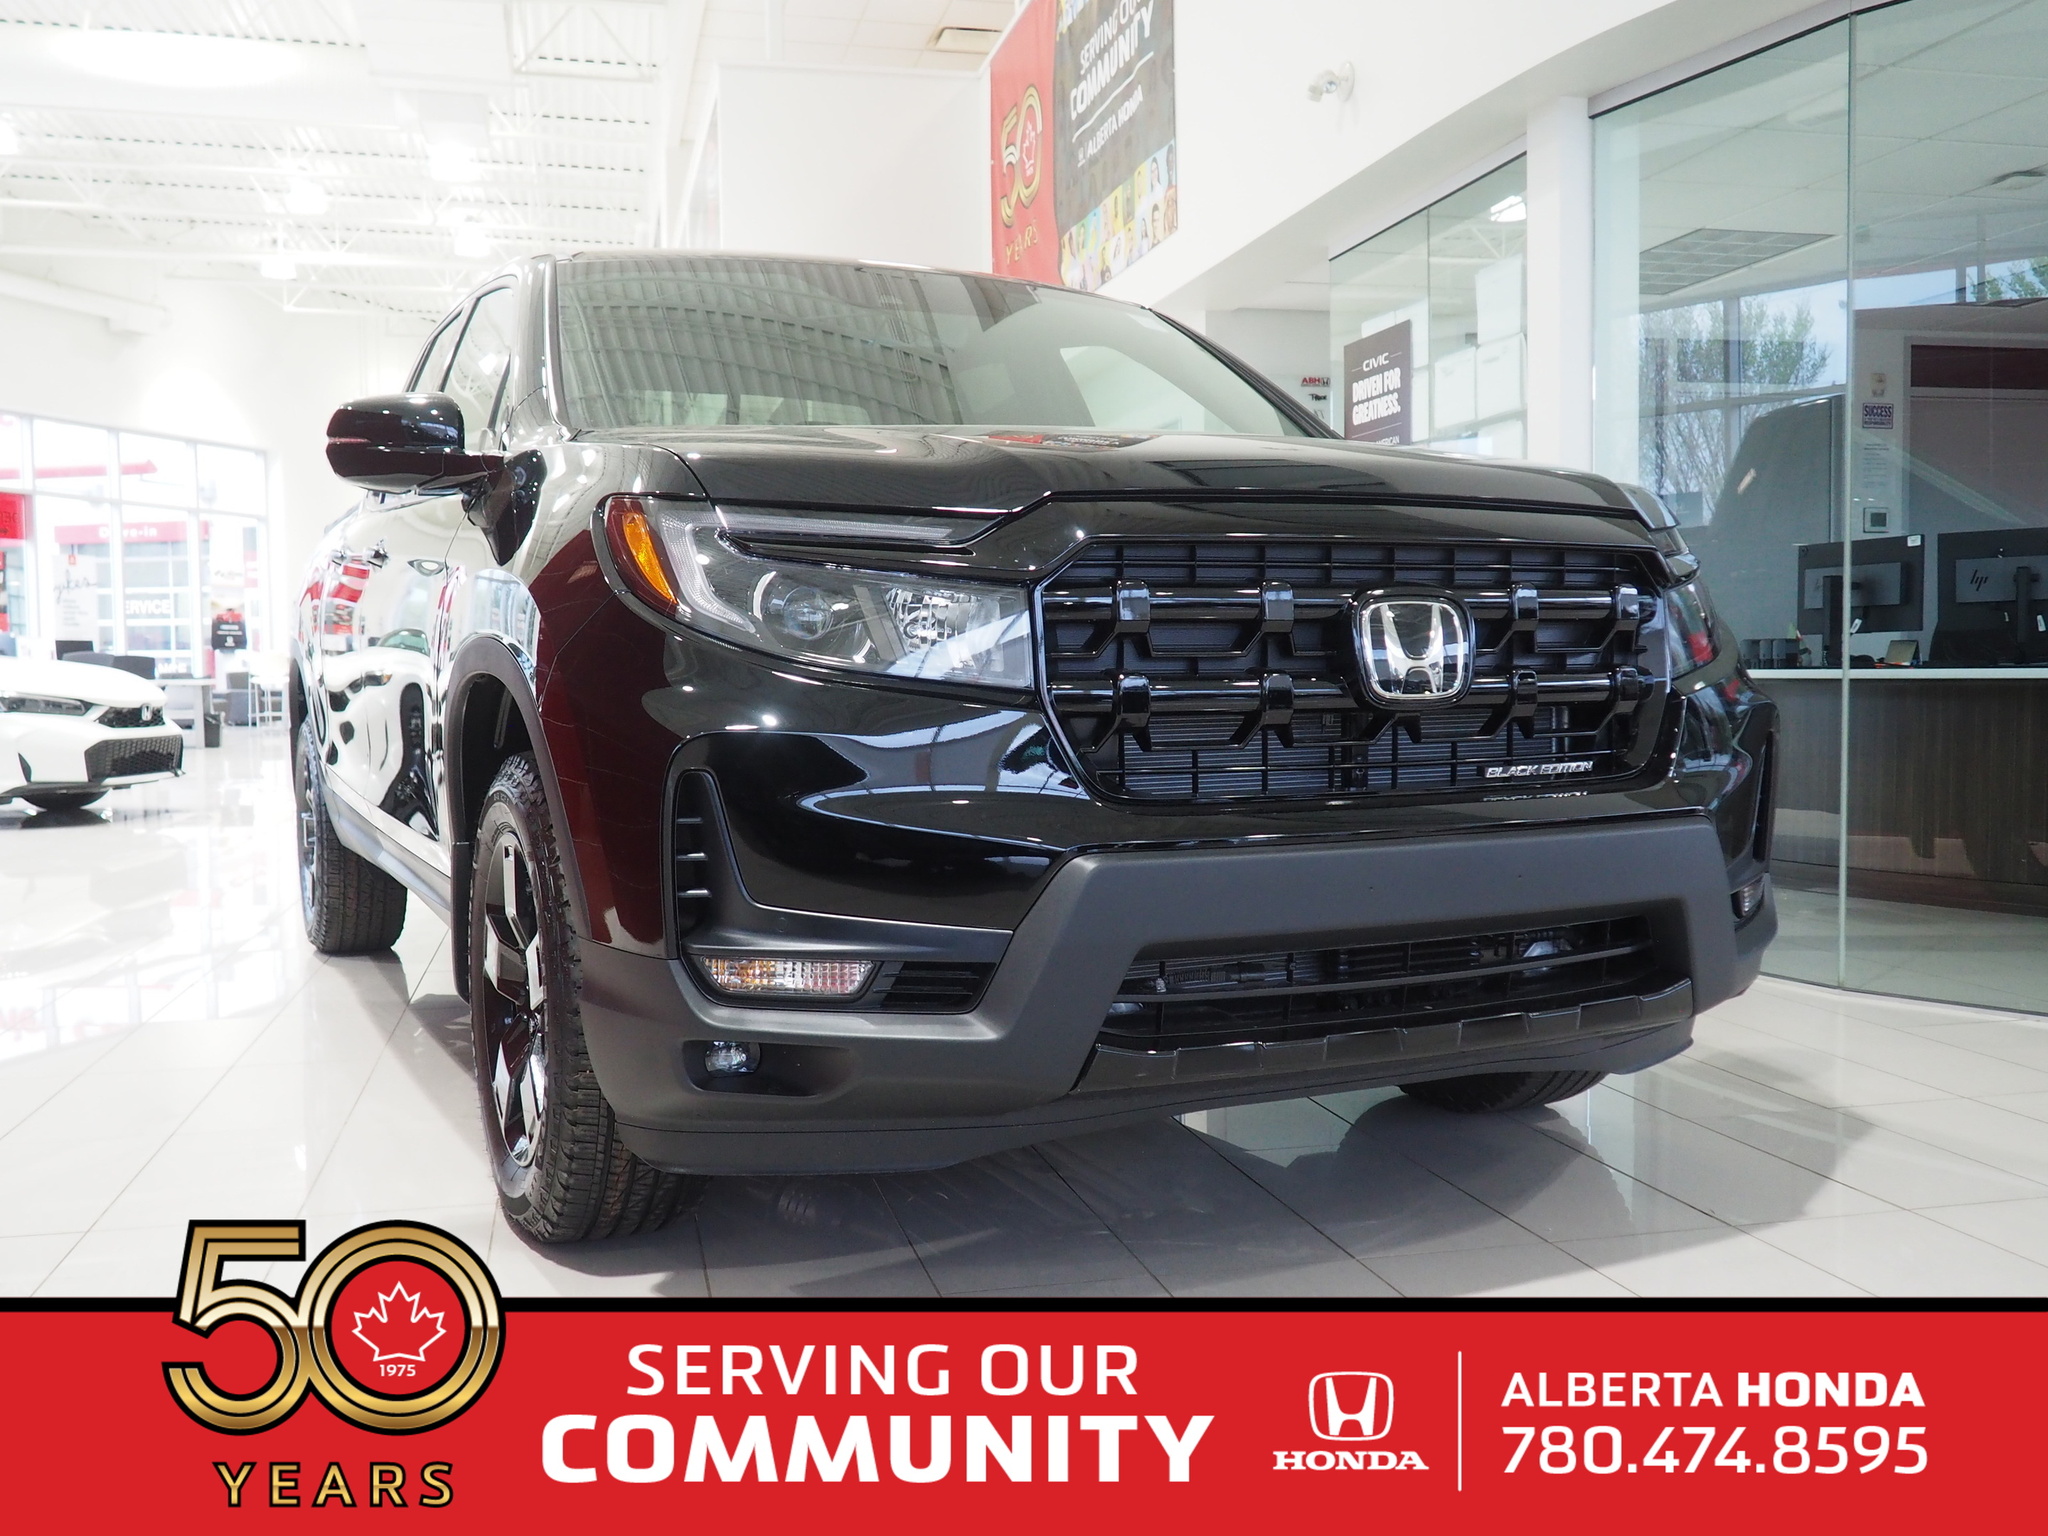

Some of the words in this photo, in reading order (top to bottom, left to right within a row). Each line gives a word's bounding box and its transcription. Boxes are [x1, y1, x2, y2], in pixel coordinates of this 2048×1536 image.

[1080, 14, 1119, 75] SERVING
[1119, 0, 1141, 24] OU
[1070, 2, 1153, 121] COMMUNITY
[1001, 85, 1043, 228] 50
[1087, 114, 1118, 159] ALBERTA
[1006, 219, 1038, 265] YEARS
[1362, 352, 1390, 371] CIVIC
[1352, 374, 1383, 402] DRIVEN
[1384, 367, 1401, 392] FOR
[1352, 392, 1401, 426] GREATNESS.
[1864, 405, 1892, 417] SUCCESS
[1486, 764, 1539, 778] BLACK
[1539, 760, 1594, 775] EDITION
